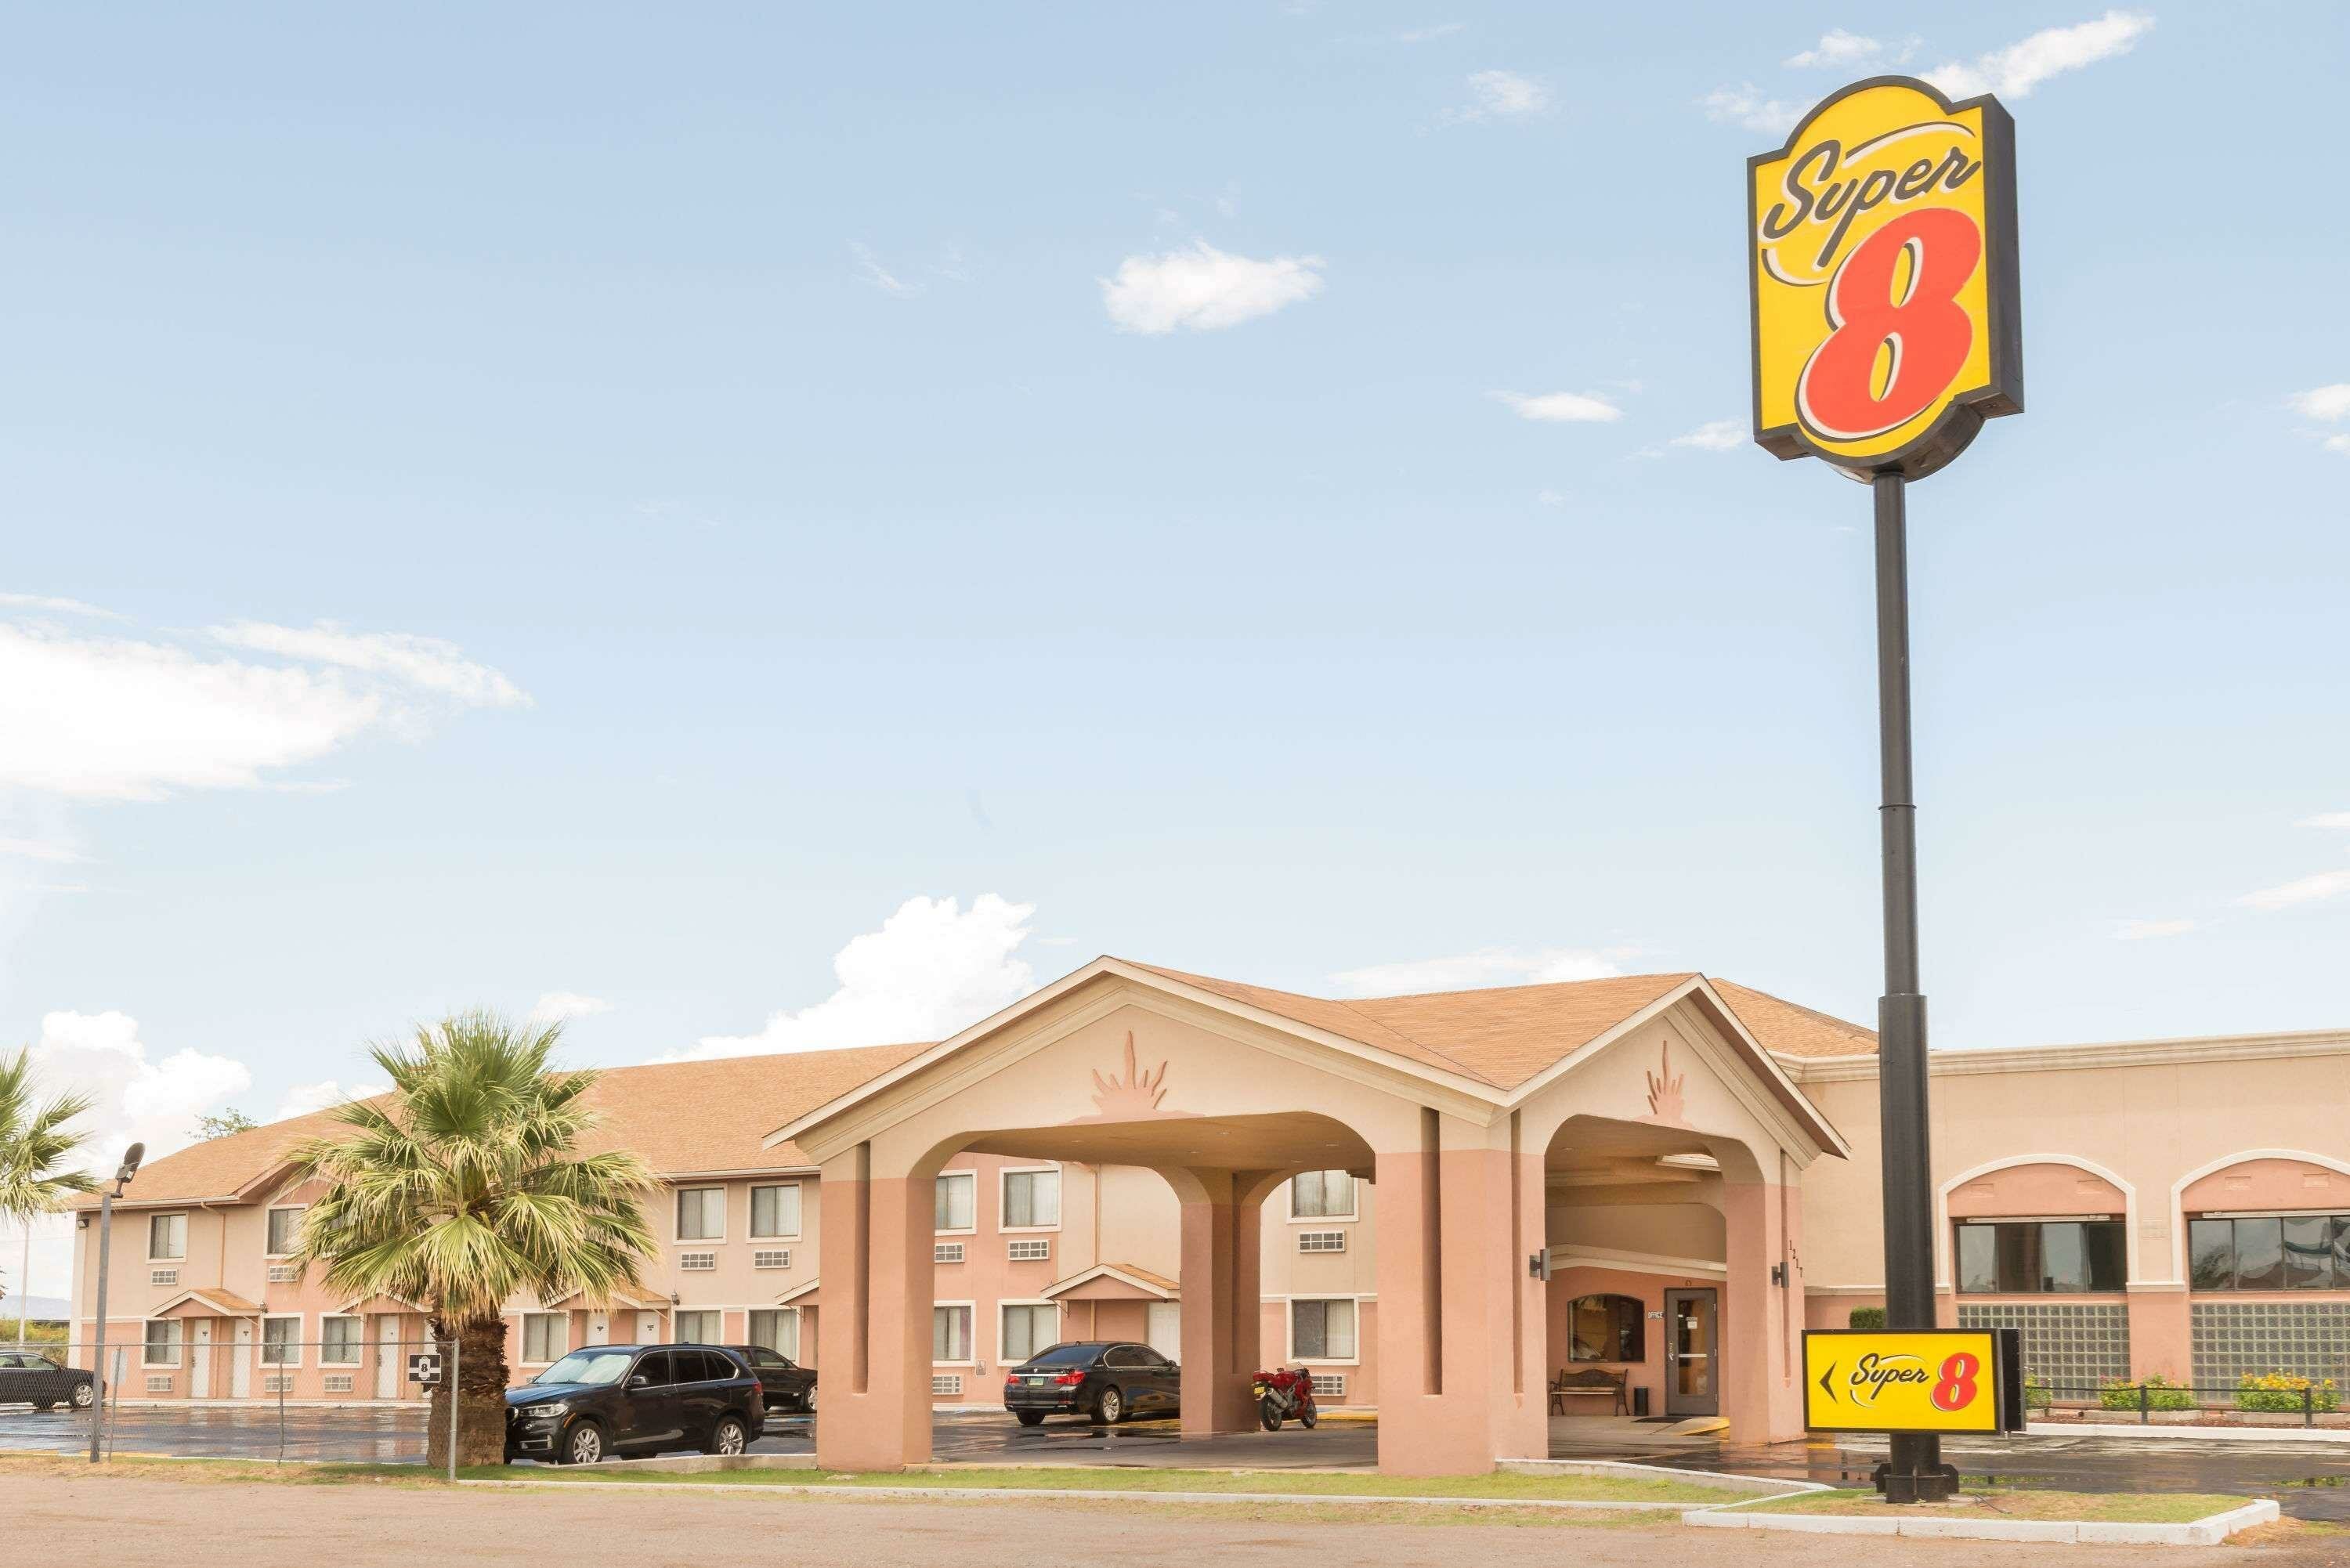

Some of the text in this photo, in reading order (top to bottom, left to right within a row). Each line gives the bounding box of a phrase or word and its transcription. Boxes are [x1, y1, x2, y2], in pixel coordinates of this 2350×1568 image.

[1760, 139, 1982, 272] Super
[1794, 207, 1982, 443] 8
[1849, 1352, 1980, 1411] Super 8
